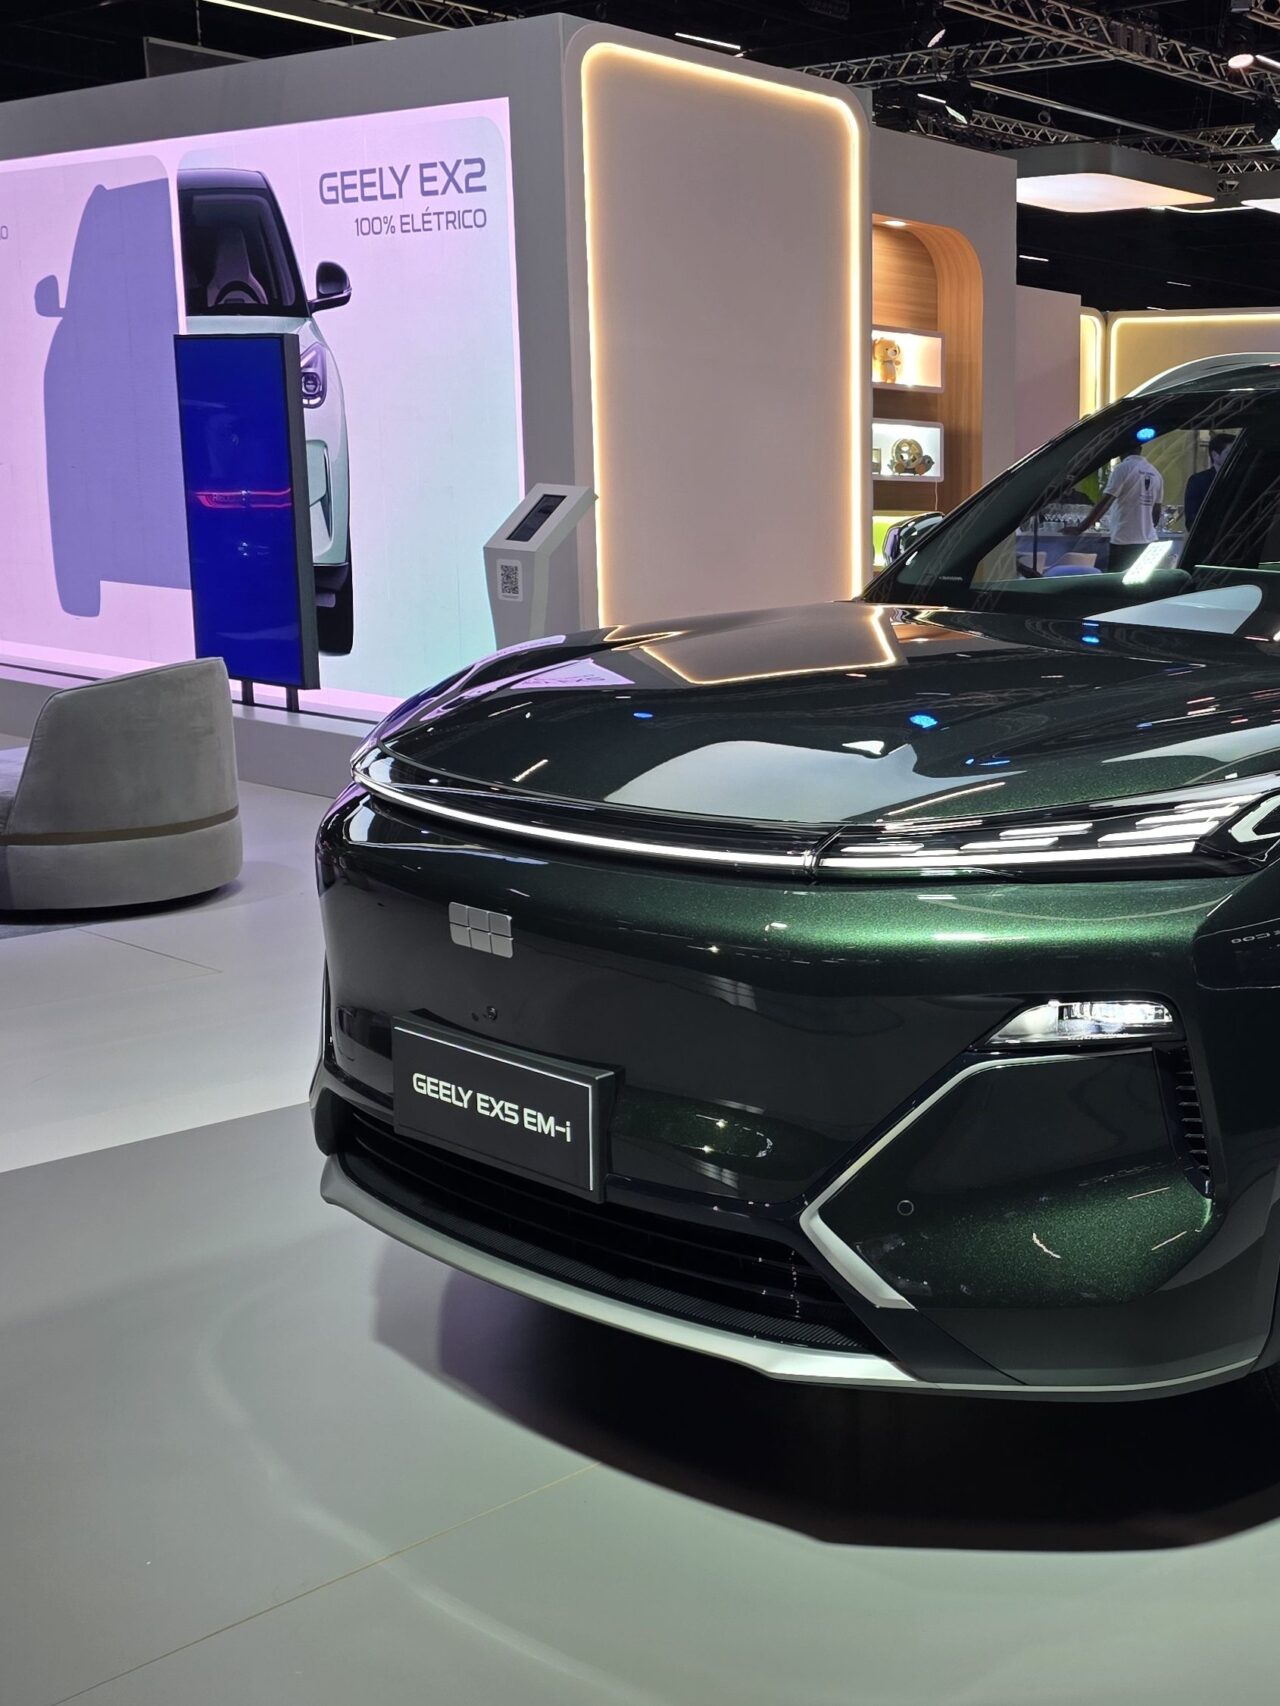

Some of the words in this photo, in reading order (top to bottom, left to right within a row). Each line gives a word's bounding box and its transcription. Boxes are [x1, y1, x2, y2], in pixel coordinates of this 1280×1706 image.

[319, 164, 411, 205] GEELY
[419, 157, 487, 197] EX2
[354, 215, 396, 236] 100%
[400, 206, 487, 234] ELÉTRICO
[412, 1072, 473, 1109] GEELY
[476, 1092, 519, 1125] EX5
[523, 1107, 571, 1142] EM-i
